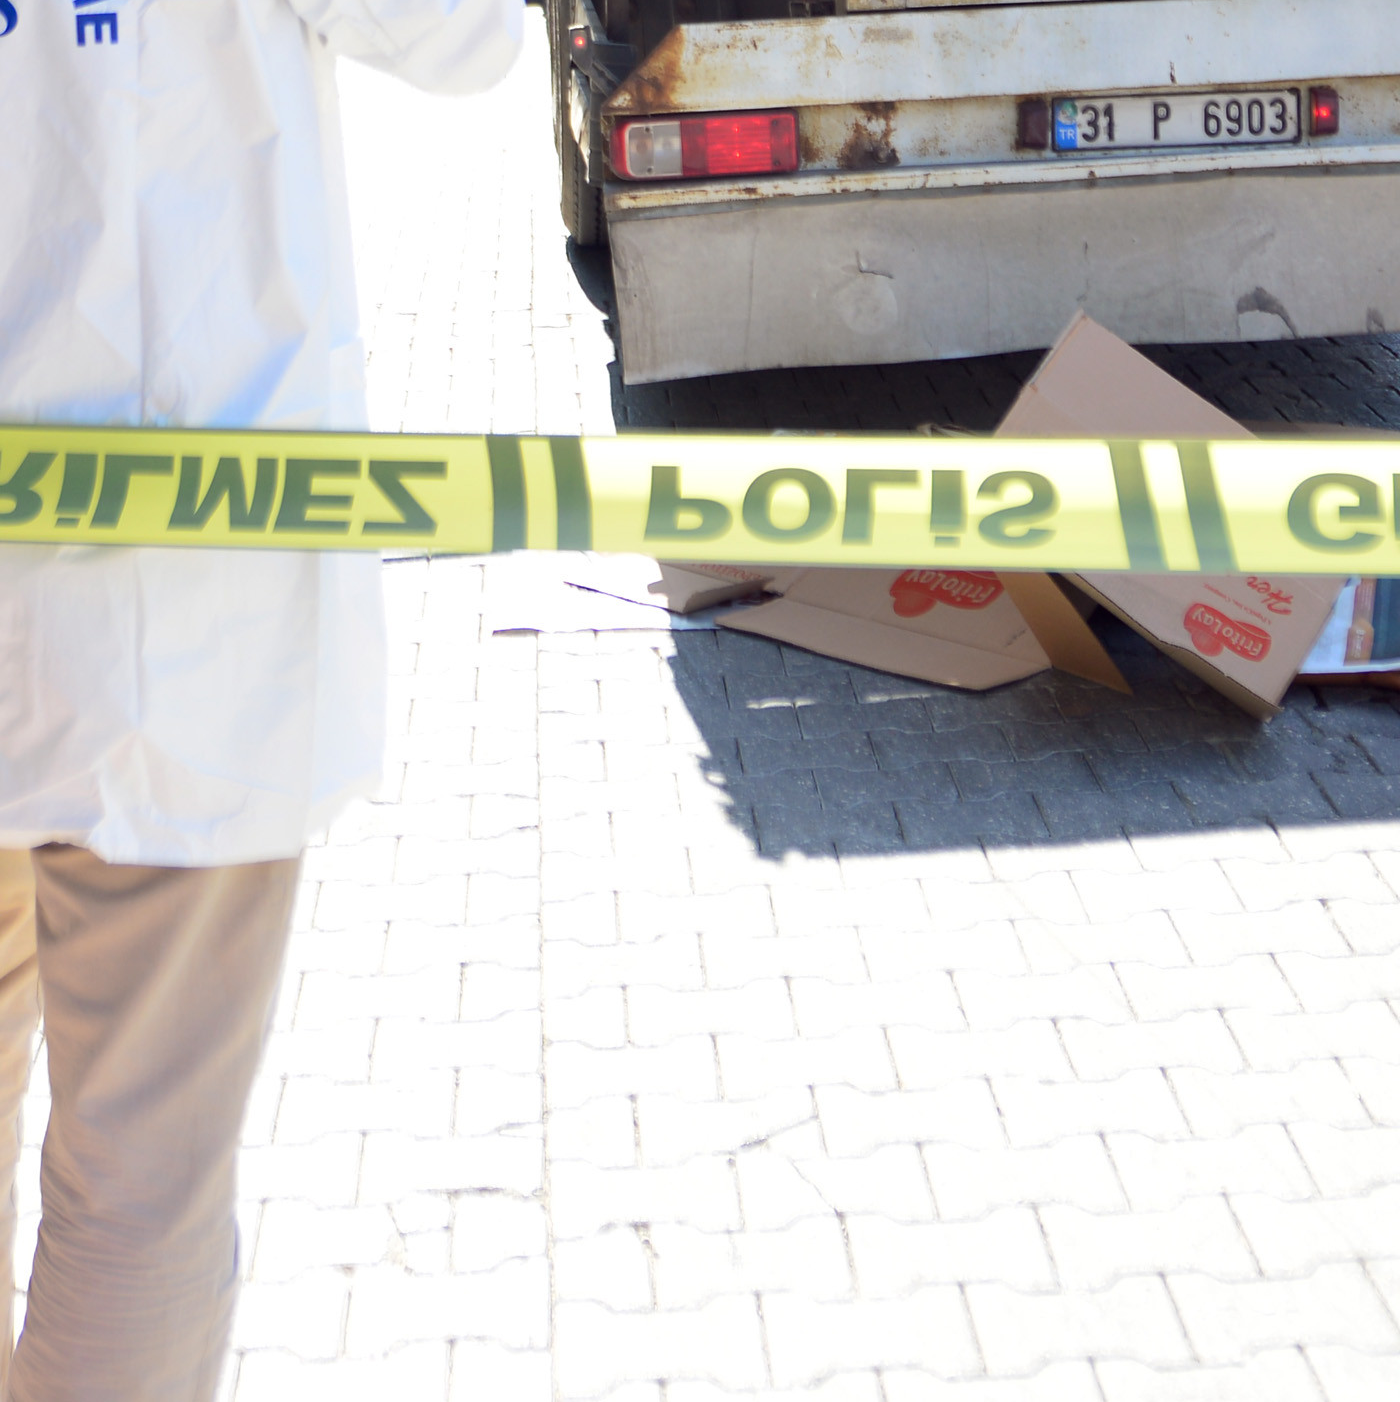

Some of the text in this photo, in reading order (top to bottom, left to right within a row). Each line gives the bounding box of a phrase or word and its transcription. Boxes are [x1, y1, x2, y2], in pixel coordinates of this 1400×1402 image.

[1059, 99, 1288, 144] TR 31 P 6903
